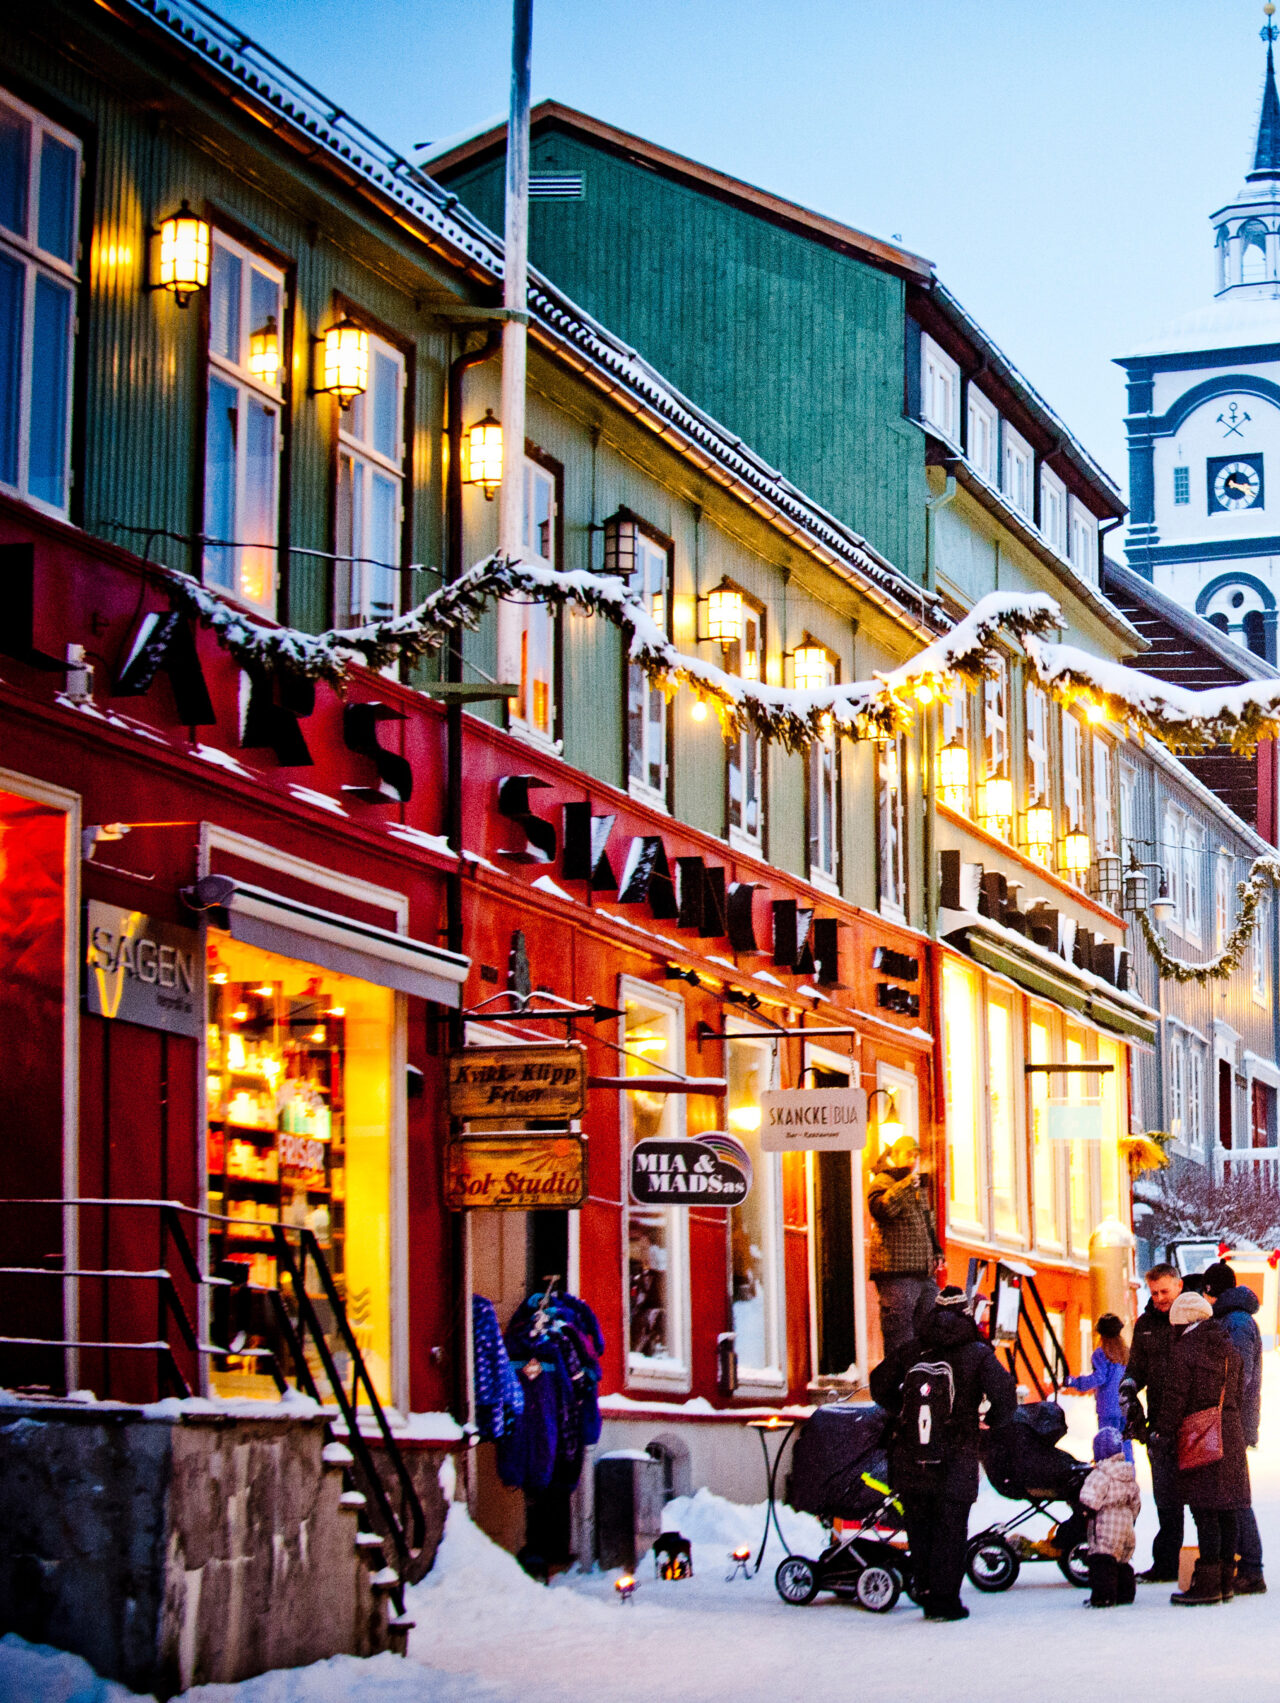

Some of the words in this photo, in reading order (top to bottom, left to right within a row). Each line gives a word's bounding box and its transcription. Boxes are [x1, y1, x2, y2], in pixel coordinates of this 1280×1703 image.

[497, 775, 853, 991] SKANCKE
[93, 927, 196, 994] SAGEN
[521, 1063, 577, 1085] Klipp
[769, 1106, 828, 1126] SKANCKE
[834, 1106, 858, 1125] BUA
[635, 1153, 688, 1173] MIA
[693, 1153, 717, 1174] &
[500, 1171, 580, 1195] Studio
